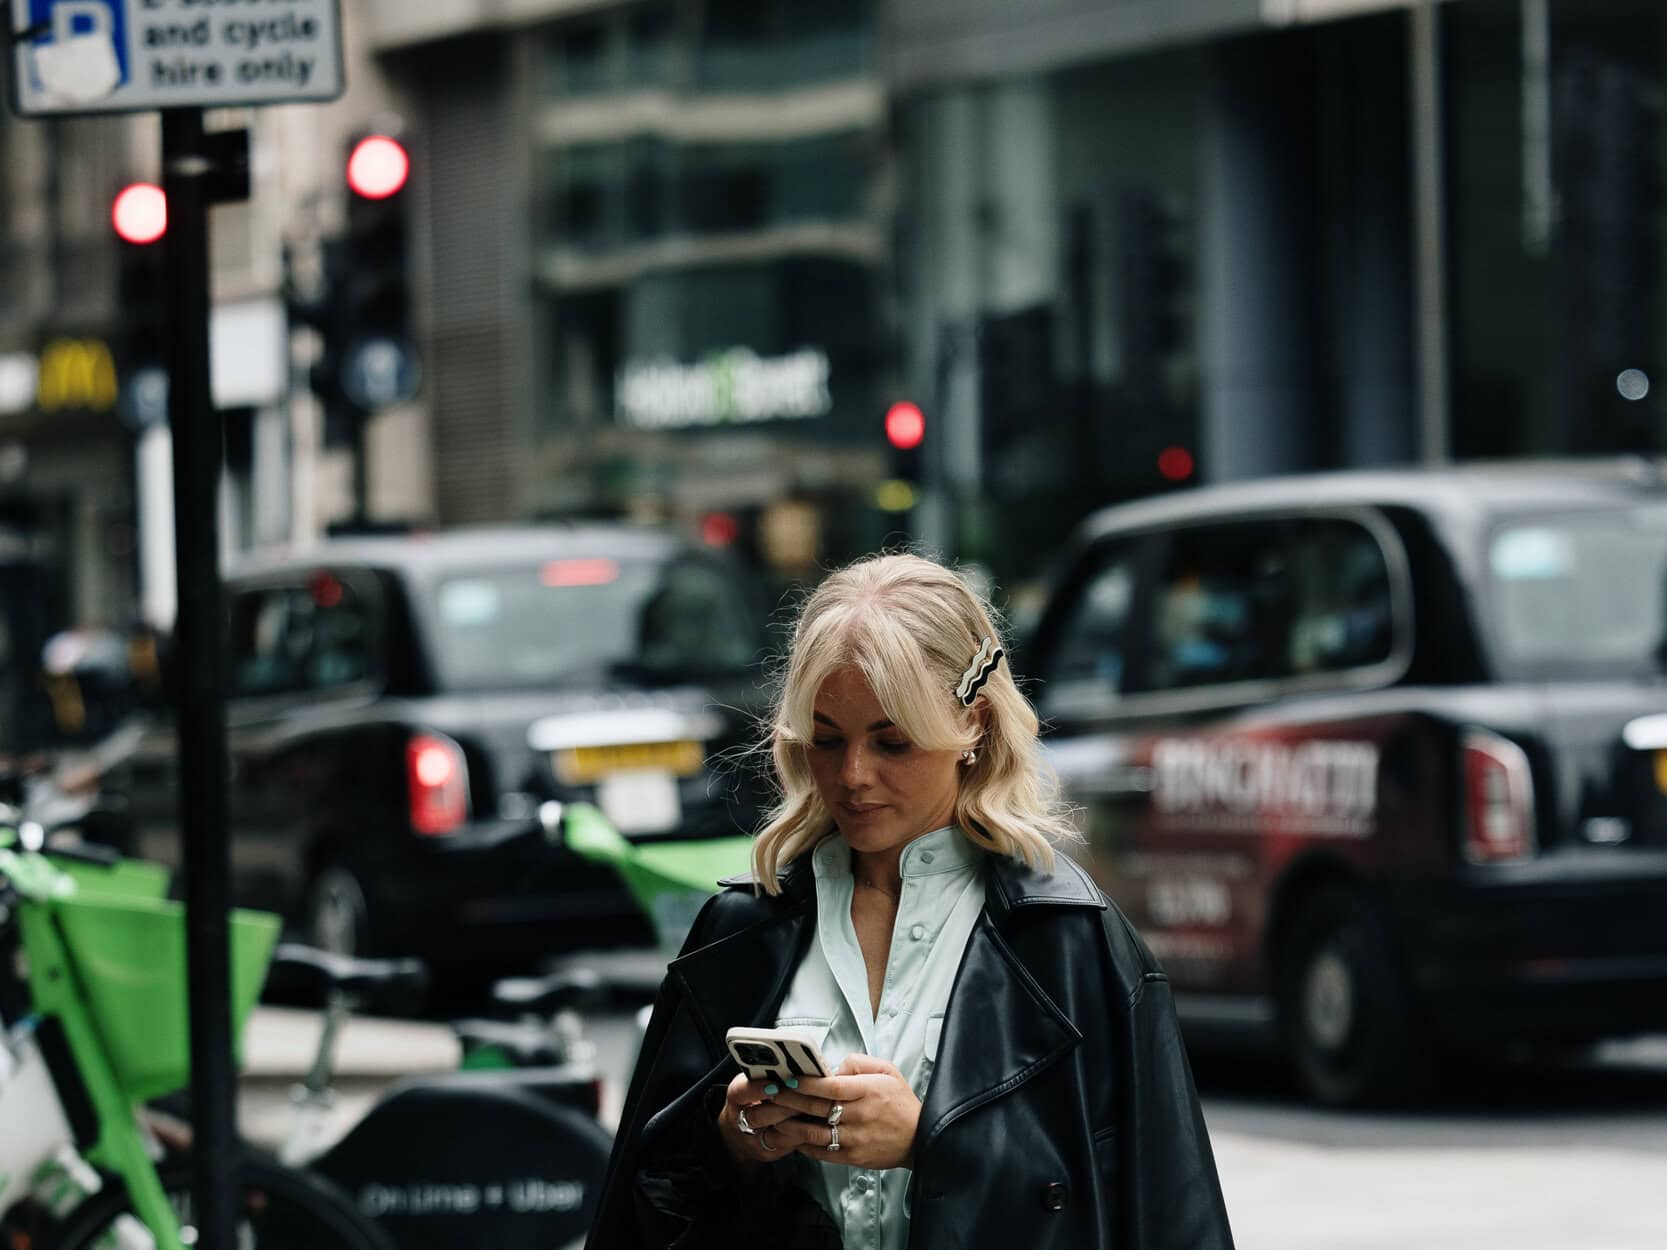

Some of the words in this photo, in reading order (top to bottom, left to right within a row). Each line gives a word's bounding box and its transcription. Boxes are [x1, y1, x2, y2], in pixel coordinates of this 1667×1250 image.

[144, 15, 210, 46] and
[222, 12, 318, 50] cycle
[153, 56, 222, 85] hire
[237, 52, 315, 87] only
[509, 1179, 583, 1211] Uber
